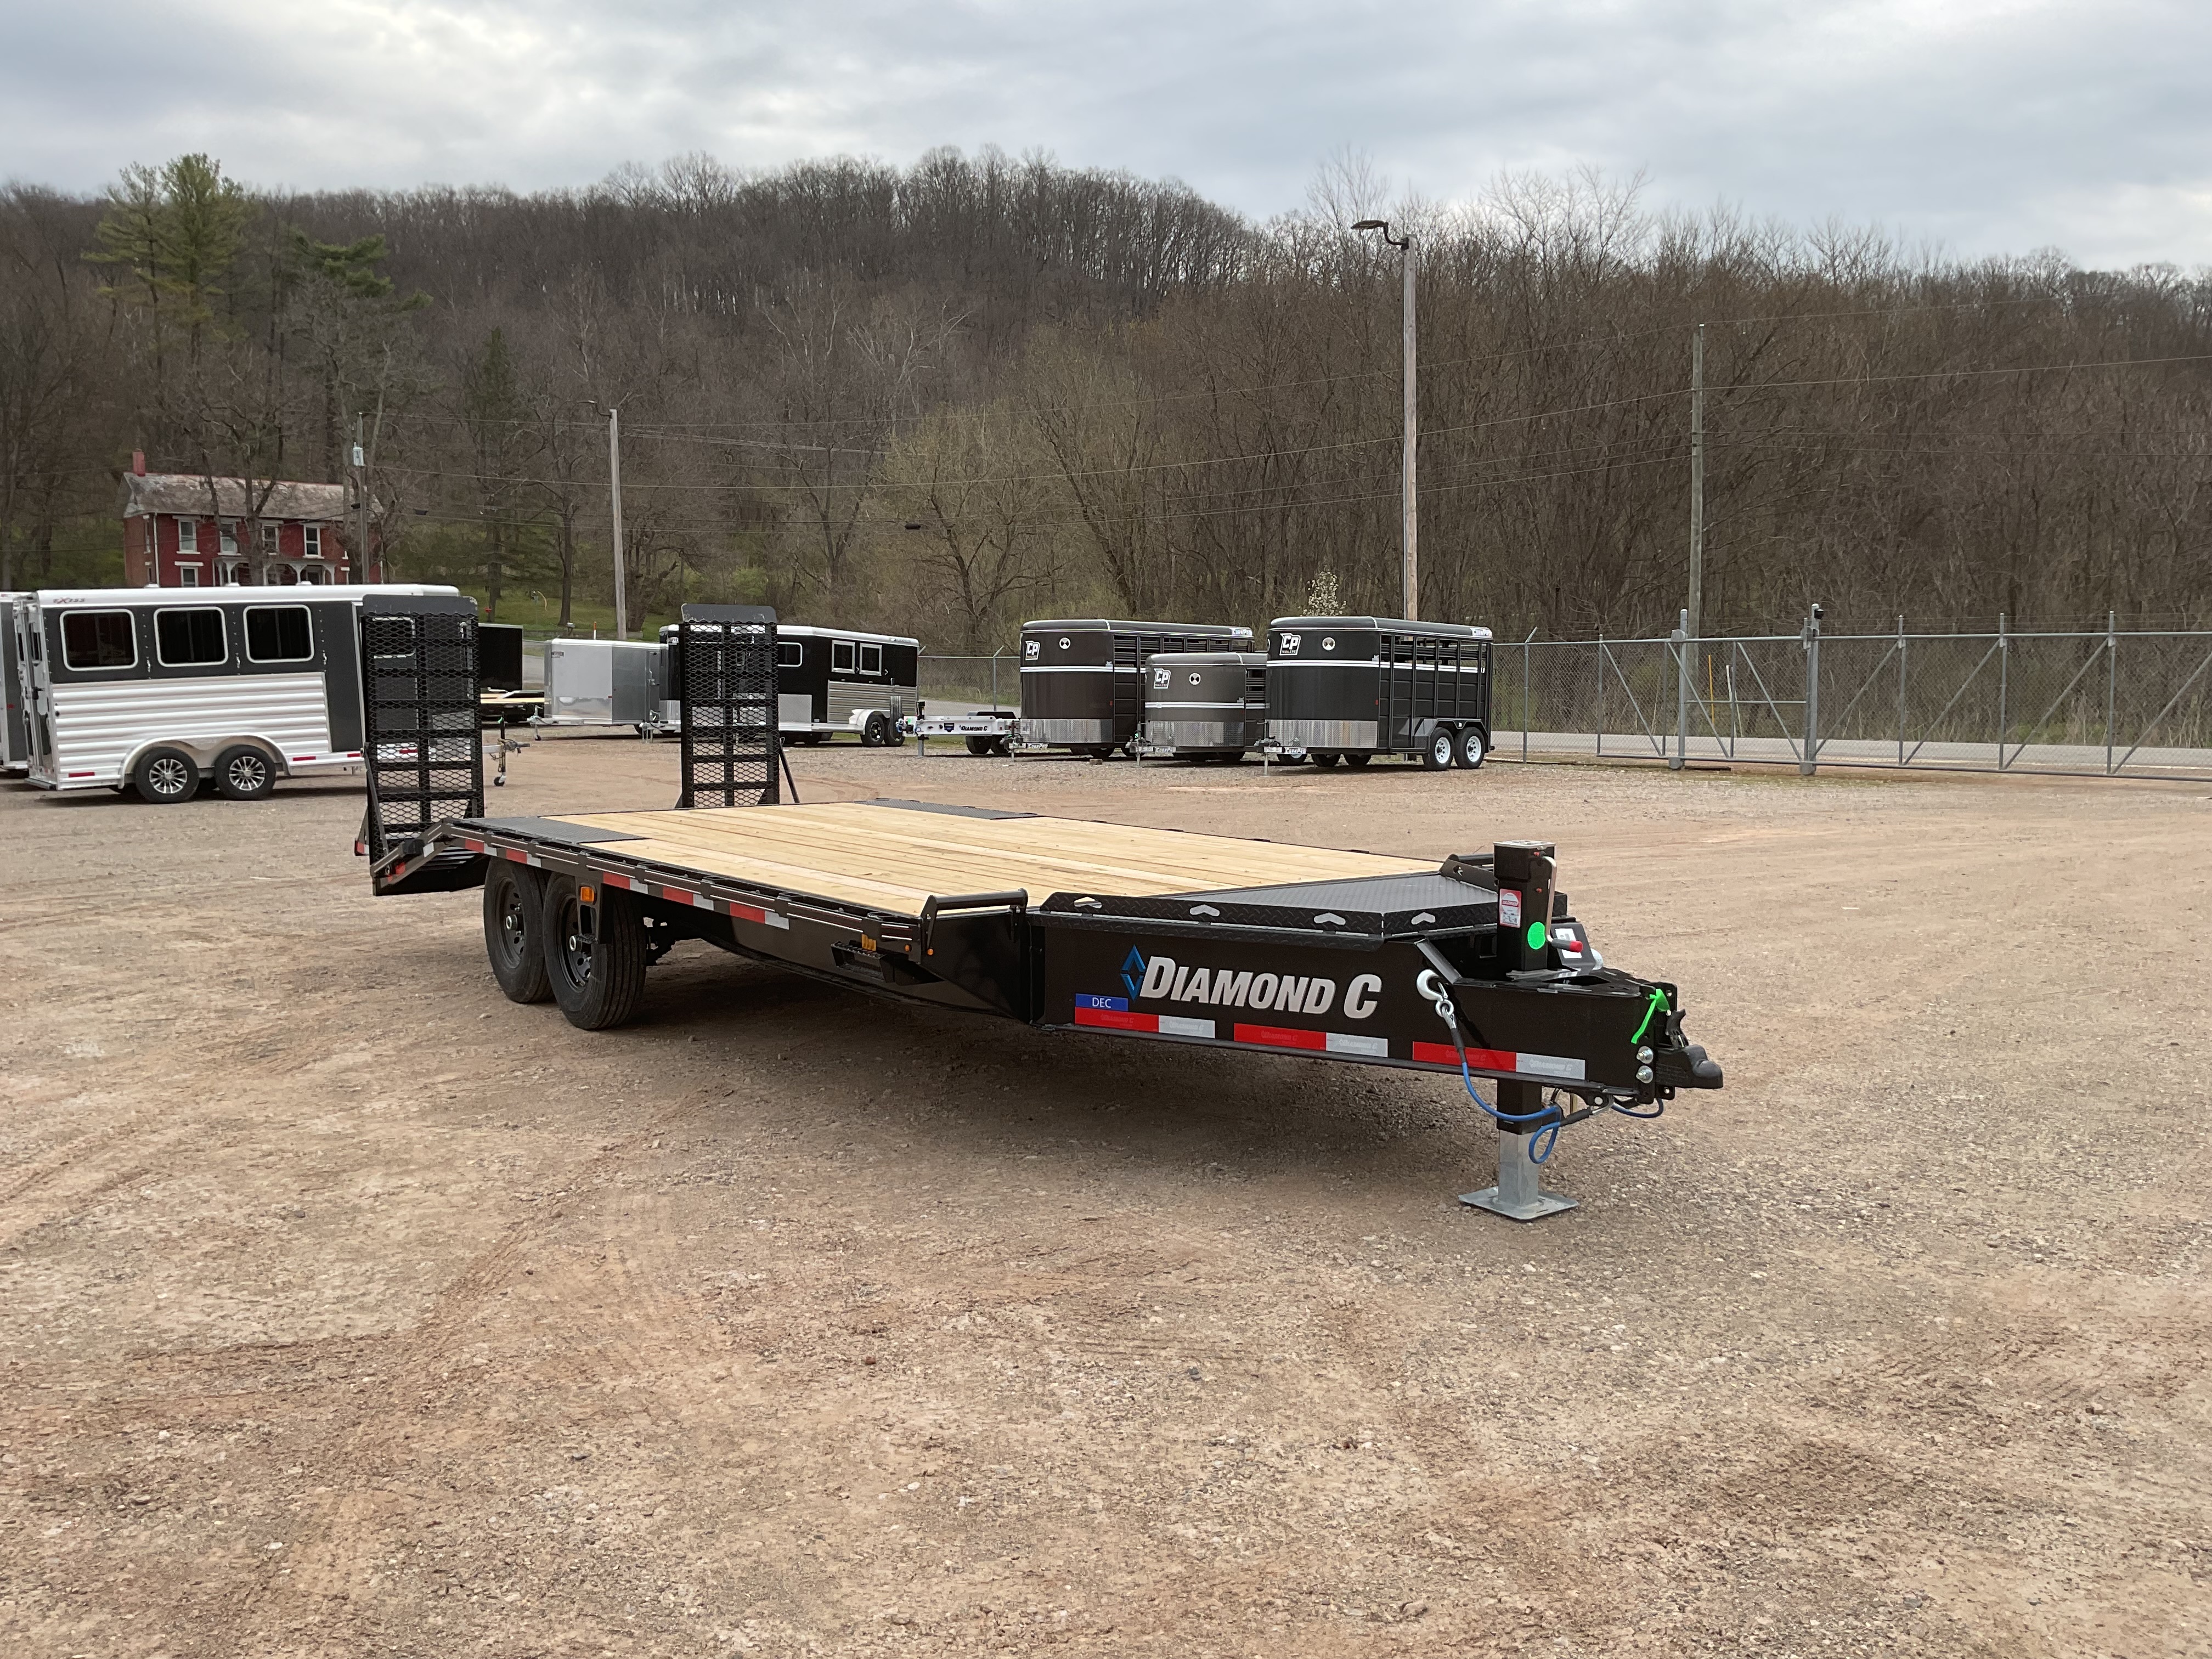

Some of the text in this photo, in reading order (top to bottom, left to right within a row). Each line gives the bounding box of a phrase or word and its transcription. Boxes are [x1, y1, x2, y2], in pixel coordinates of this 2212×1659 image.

[1028, 642, 1039, 655] CP
[1283, 635, 1299, 650] CP
[1156, 670, 1169, 684] CP
[1139, 956, 1382, 1019] DIAMOND C
[1092, 997, 1111, 1008] DEC
